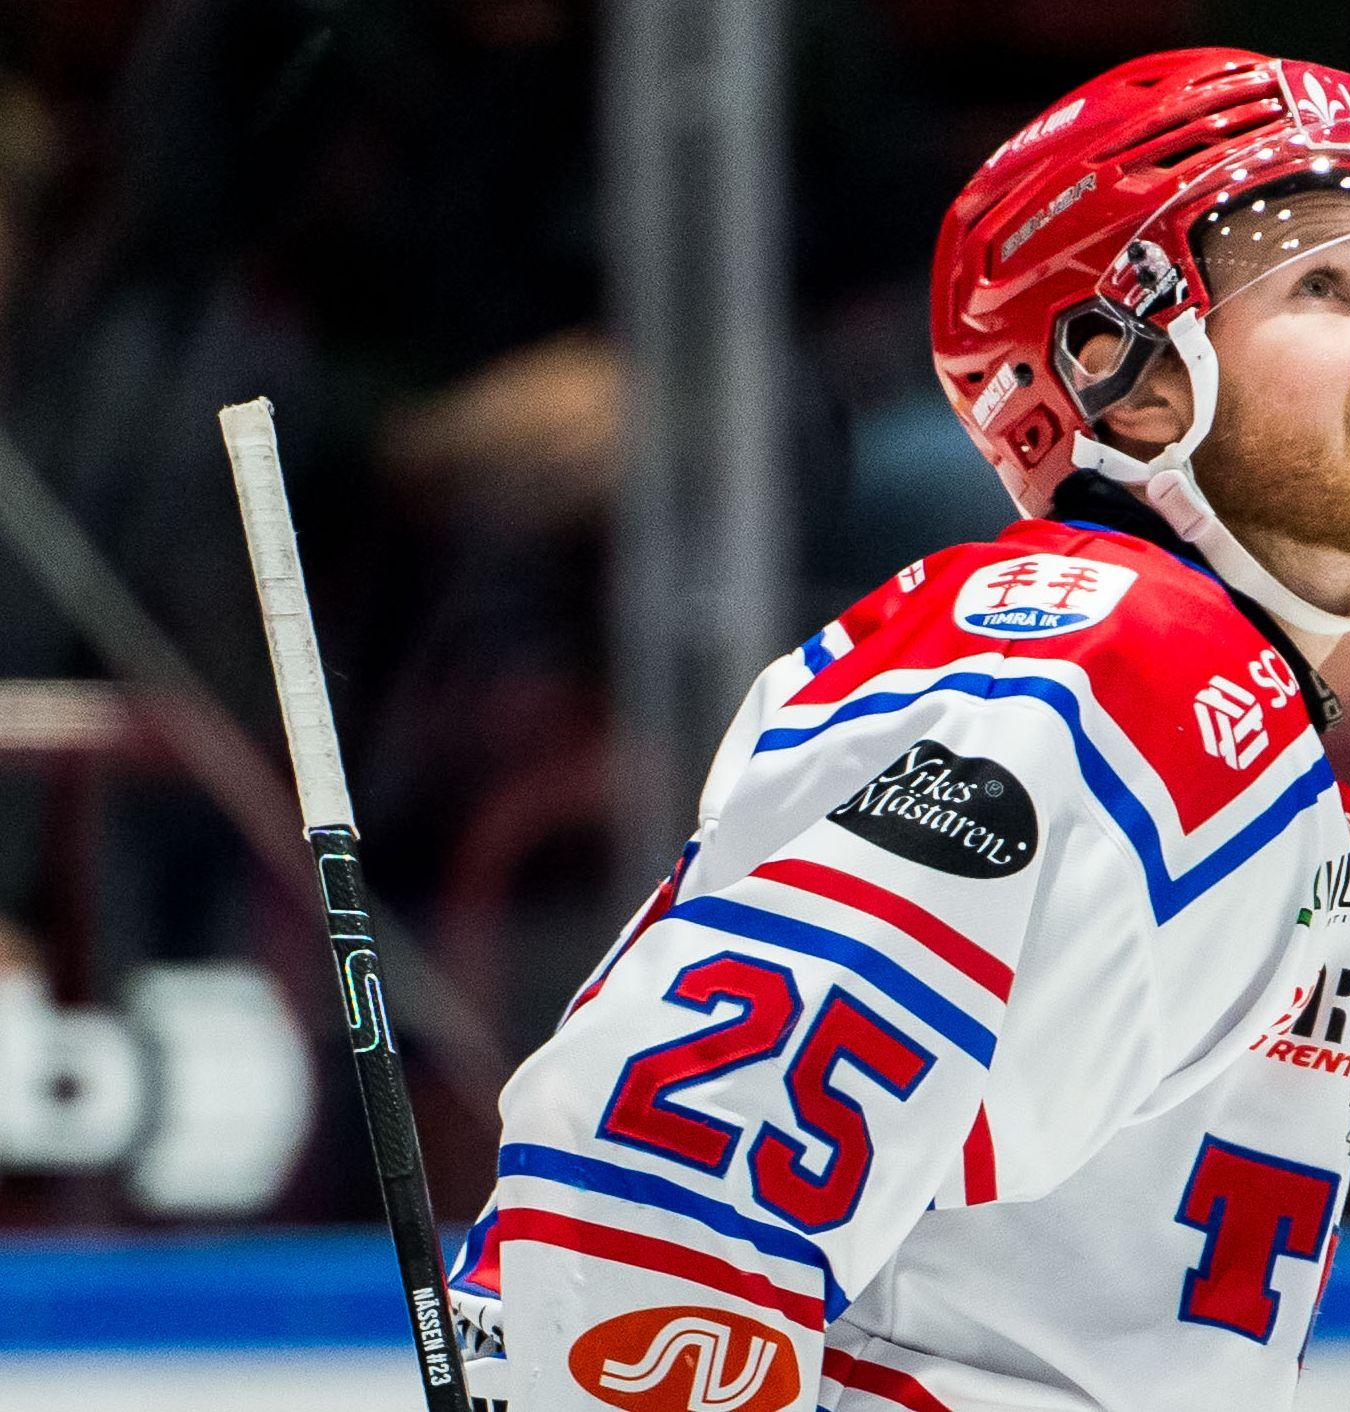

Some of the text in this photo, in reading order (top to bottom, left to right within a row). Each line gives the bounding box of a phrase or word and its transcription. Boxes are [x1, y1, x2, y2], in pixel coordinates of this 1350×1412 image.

[982, 610, 1061, 627] TIMRÅ IK
[1249, 649, 1300, 708] SC
[879, 746, 977, 803] Yrkes
[595, 950, 938, 1235] 25
[1175, 1132, 1342, 1346] T
[413, 1287, 452, 1386] NÄSSEN #23
